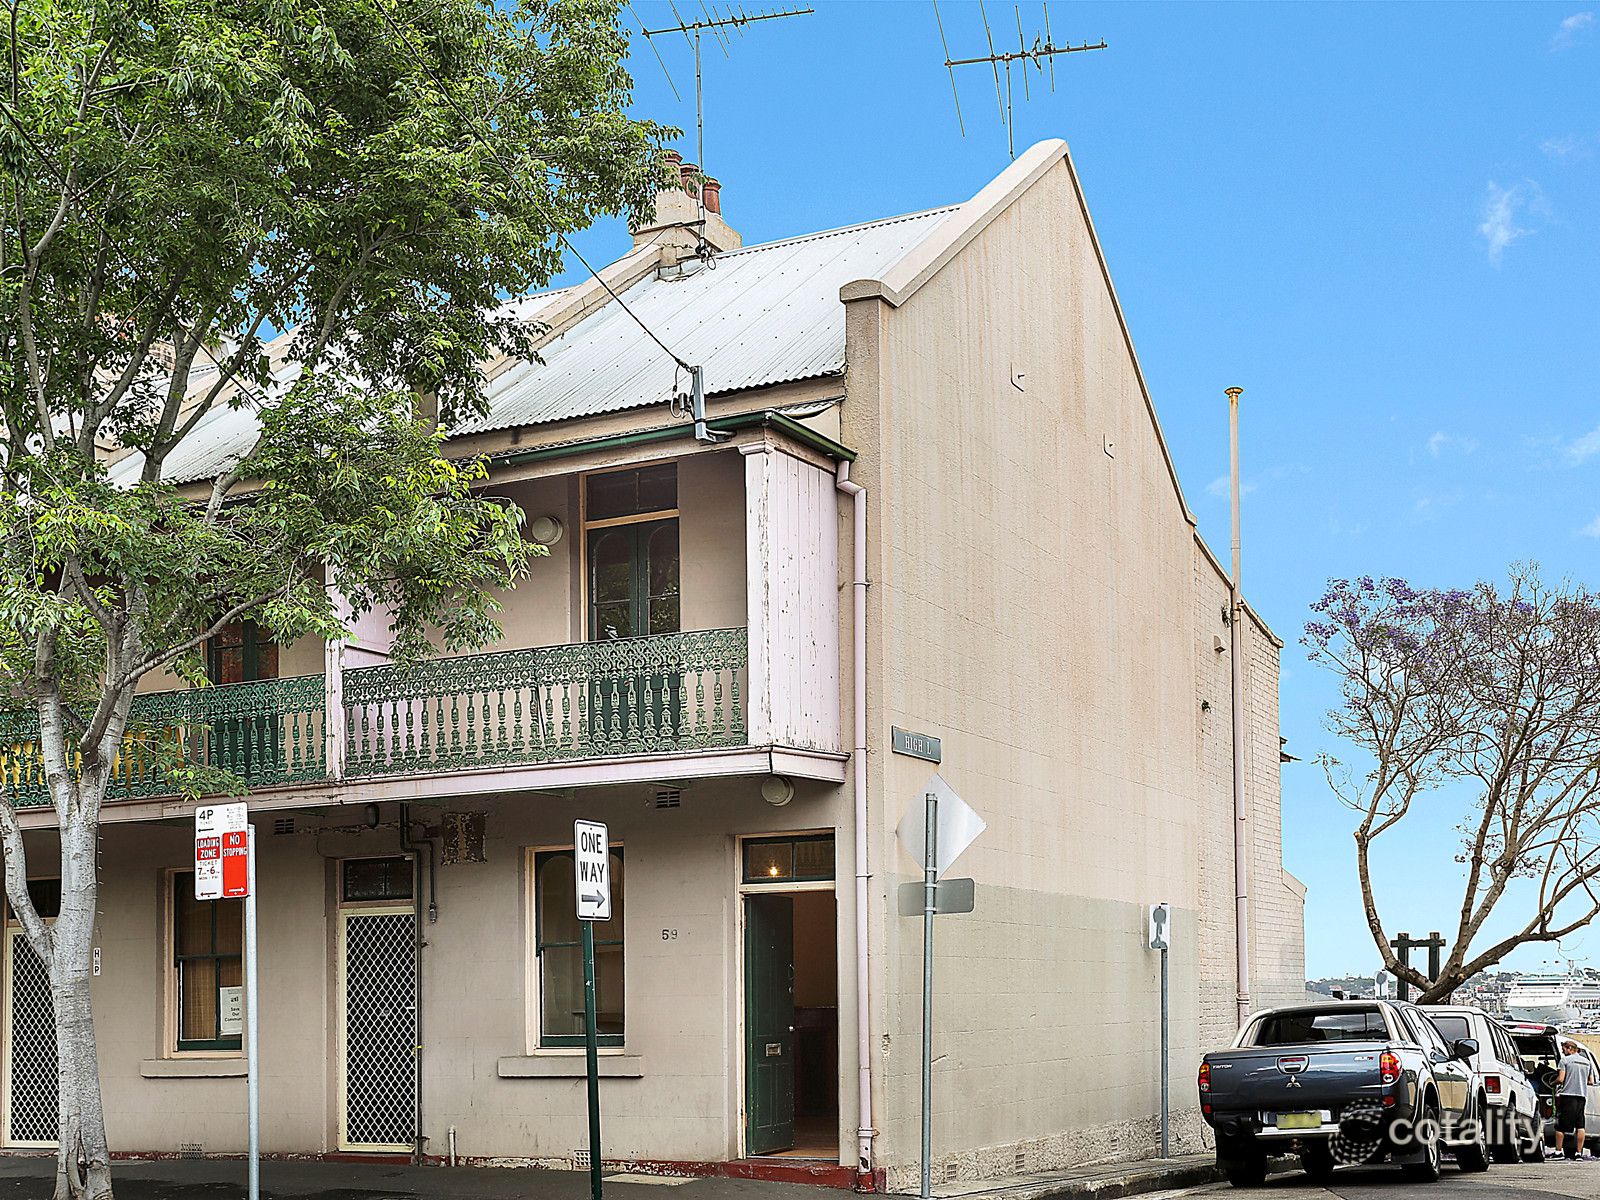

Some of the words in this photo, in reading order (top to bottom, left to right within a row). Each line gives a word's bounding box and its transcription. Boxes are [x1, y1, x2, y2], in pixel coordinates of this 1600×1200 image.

[905, 735, 923, 752] HIGH
[199, 809, 214, 820] 4P
[197, 838, 220, 848] LOADING
[229, 834, 241, 846] NO
[581, 832, 603, 854] ONE
[200, 848, 217, 859] ZONE
[223, 846, 247, 857] STOPPING
[580, 861, 605, 883] WAY
[661, 929, 678, 941] 59
